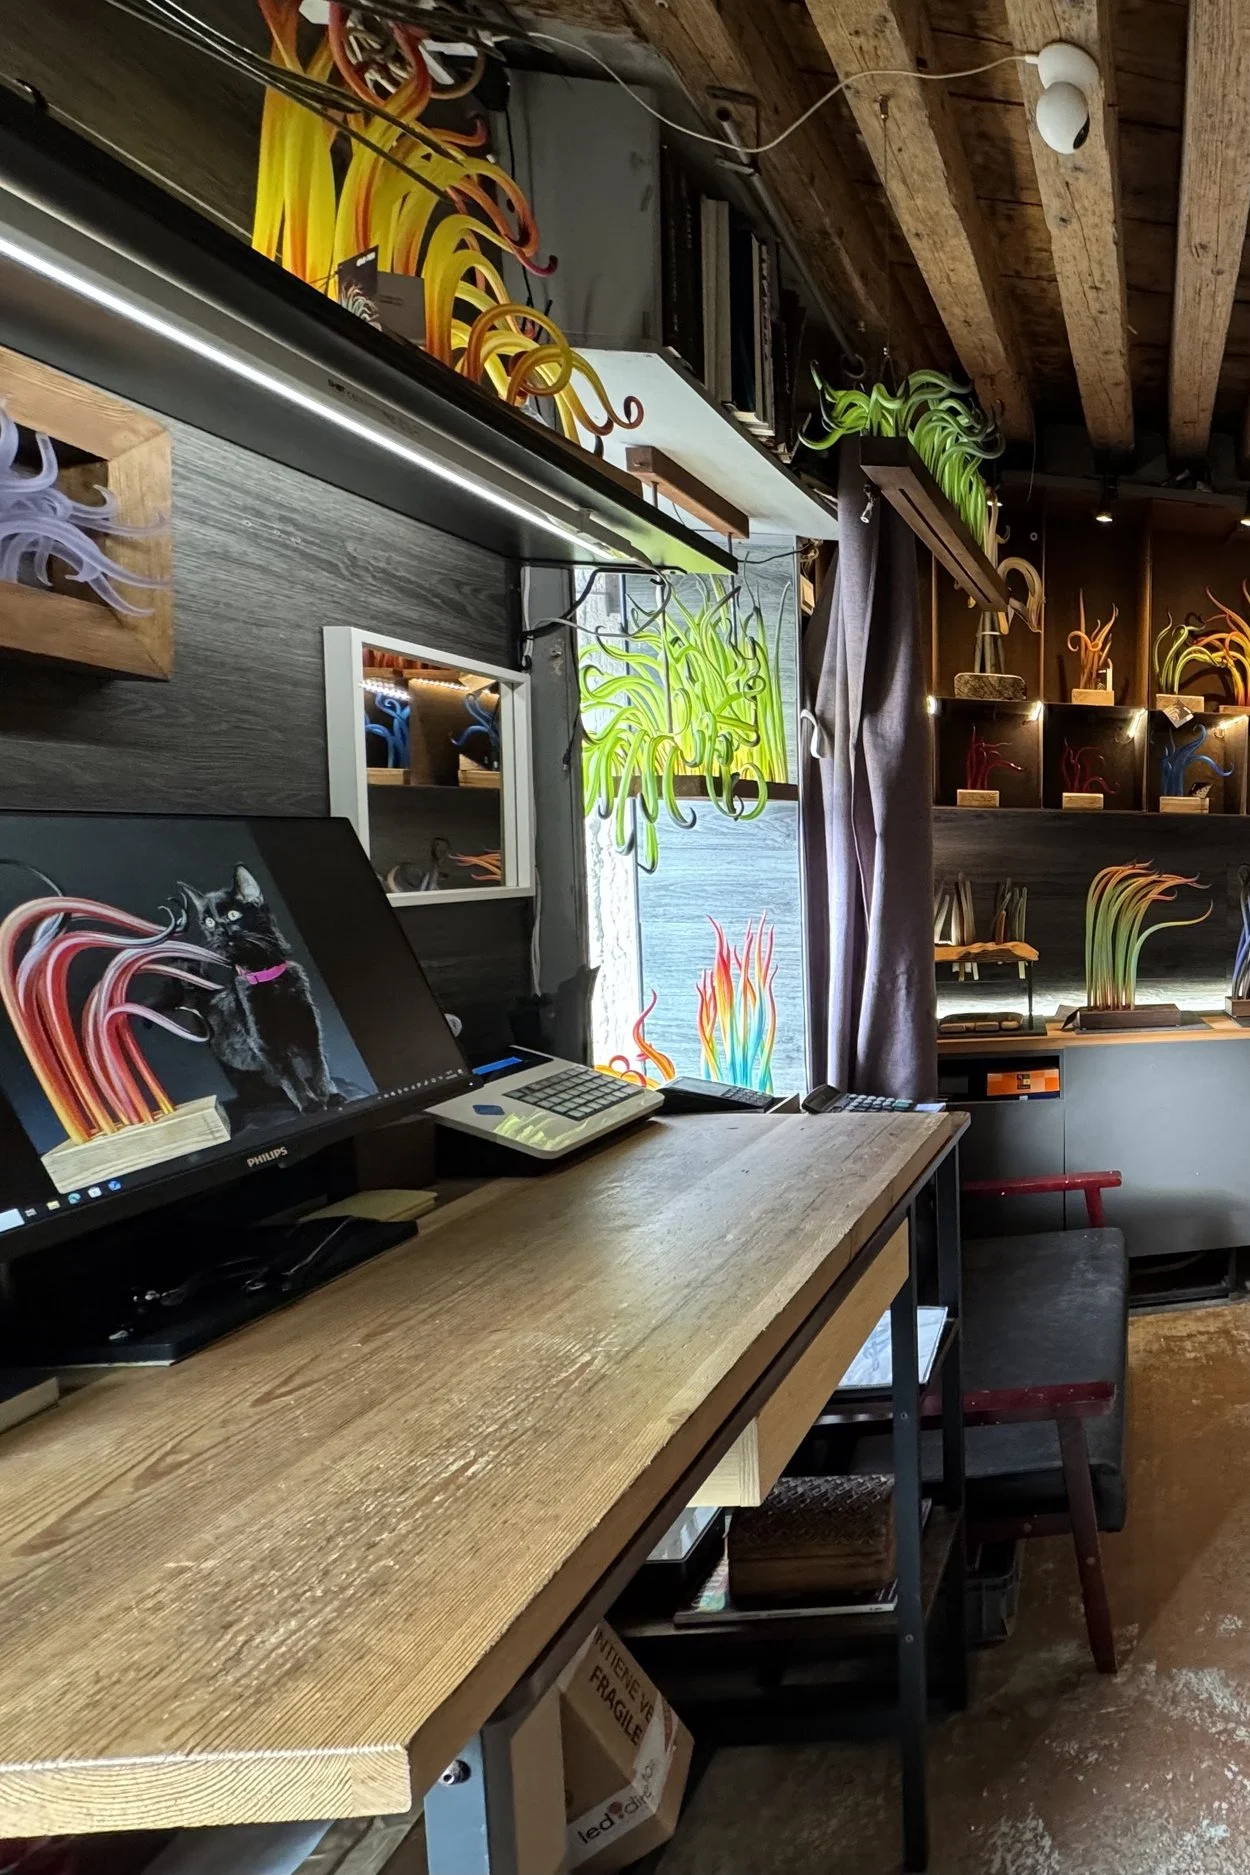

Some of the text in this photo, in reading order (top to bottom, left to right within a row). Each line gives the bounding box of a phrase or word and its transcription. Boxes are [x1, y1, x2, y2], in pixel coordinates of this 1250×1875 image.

[246, 1146, 288, 1168] PHILIPS
[590, 1664, 642, 1746] FRAGILE
[577, 1812, 615, 1844] led
